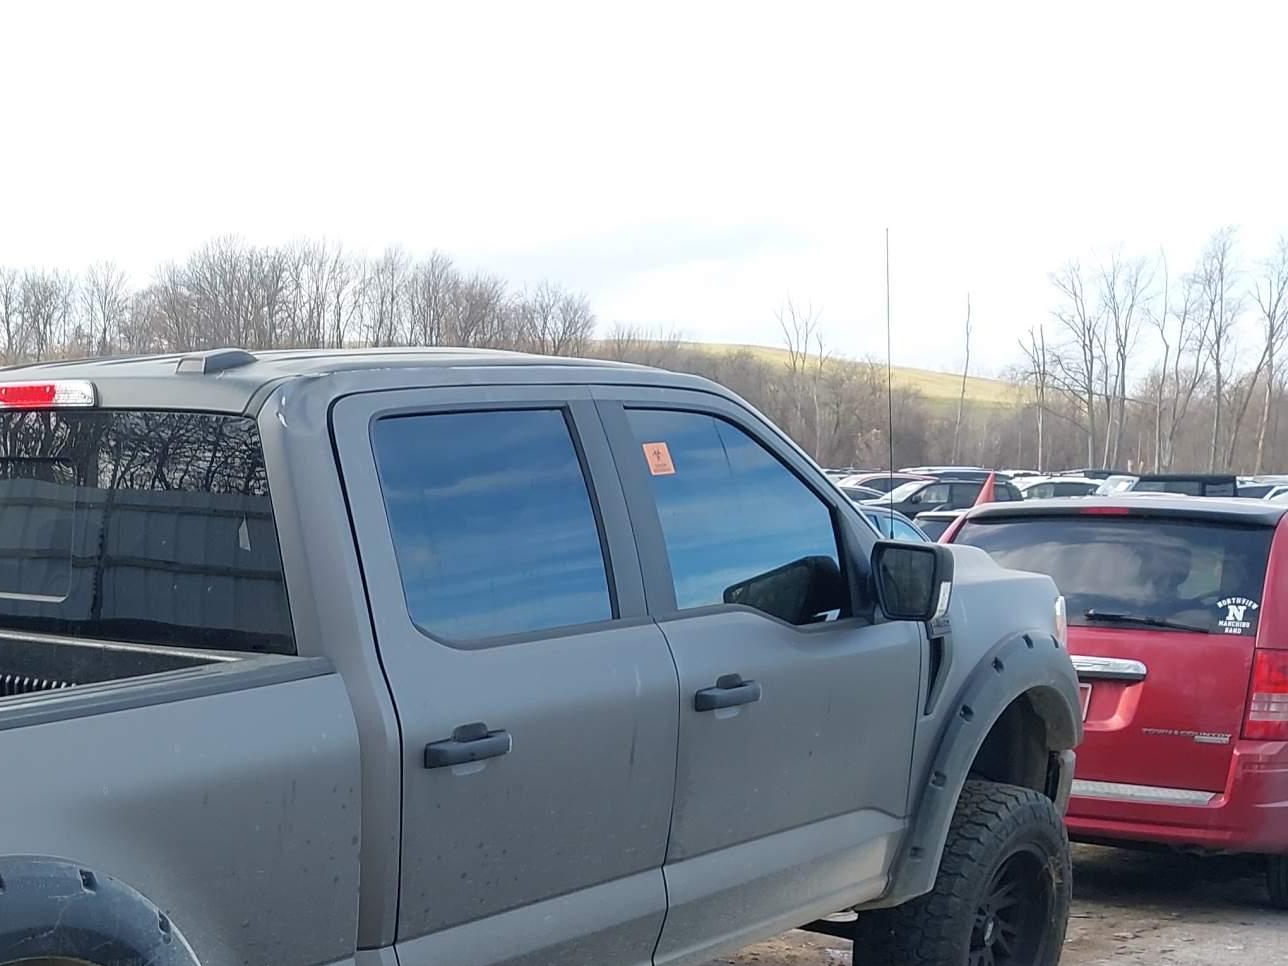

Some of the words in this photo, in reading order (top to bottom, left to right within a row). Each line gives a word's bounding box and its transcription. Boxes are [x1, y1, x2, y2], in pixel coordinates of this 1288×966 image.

[1216, 597, 1259, 610] NORTHVIEW
[1225, 605, 1247, 621] N
[1218, 620, 1251, 628] MARCHING
